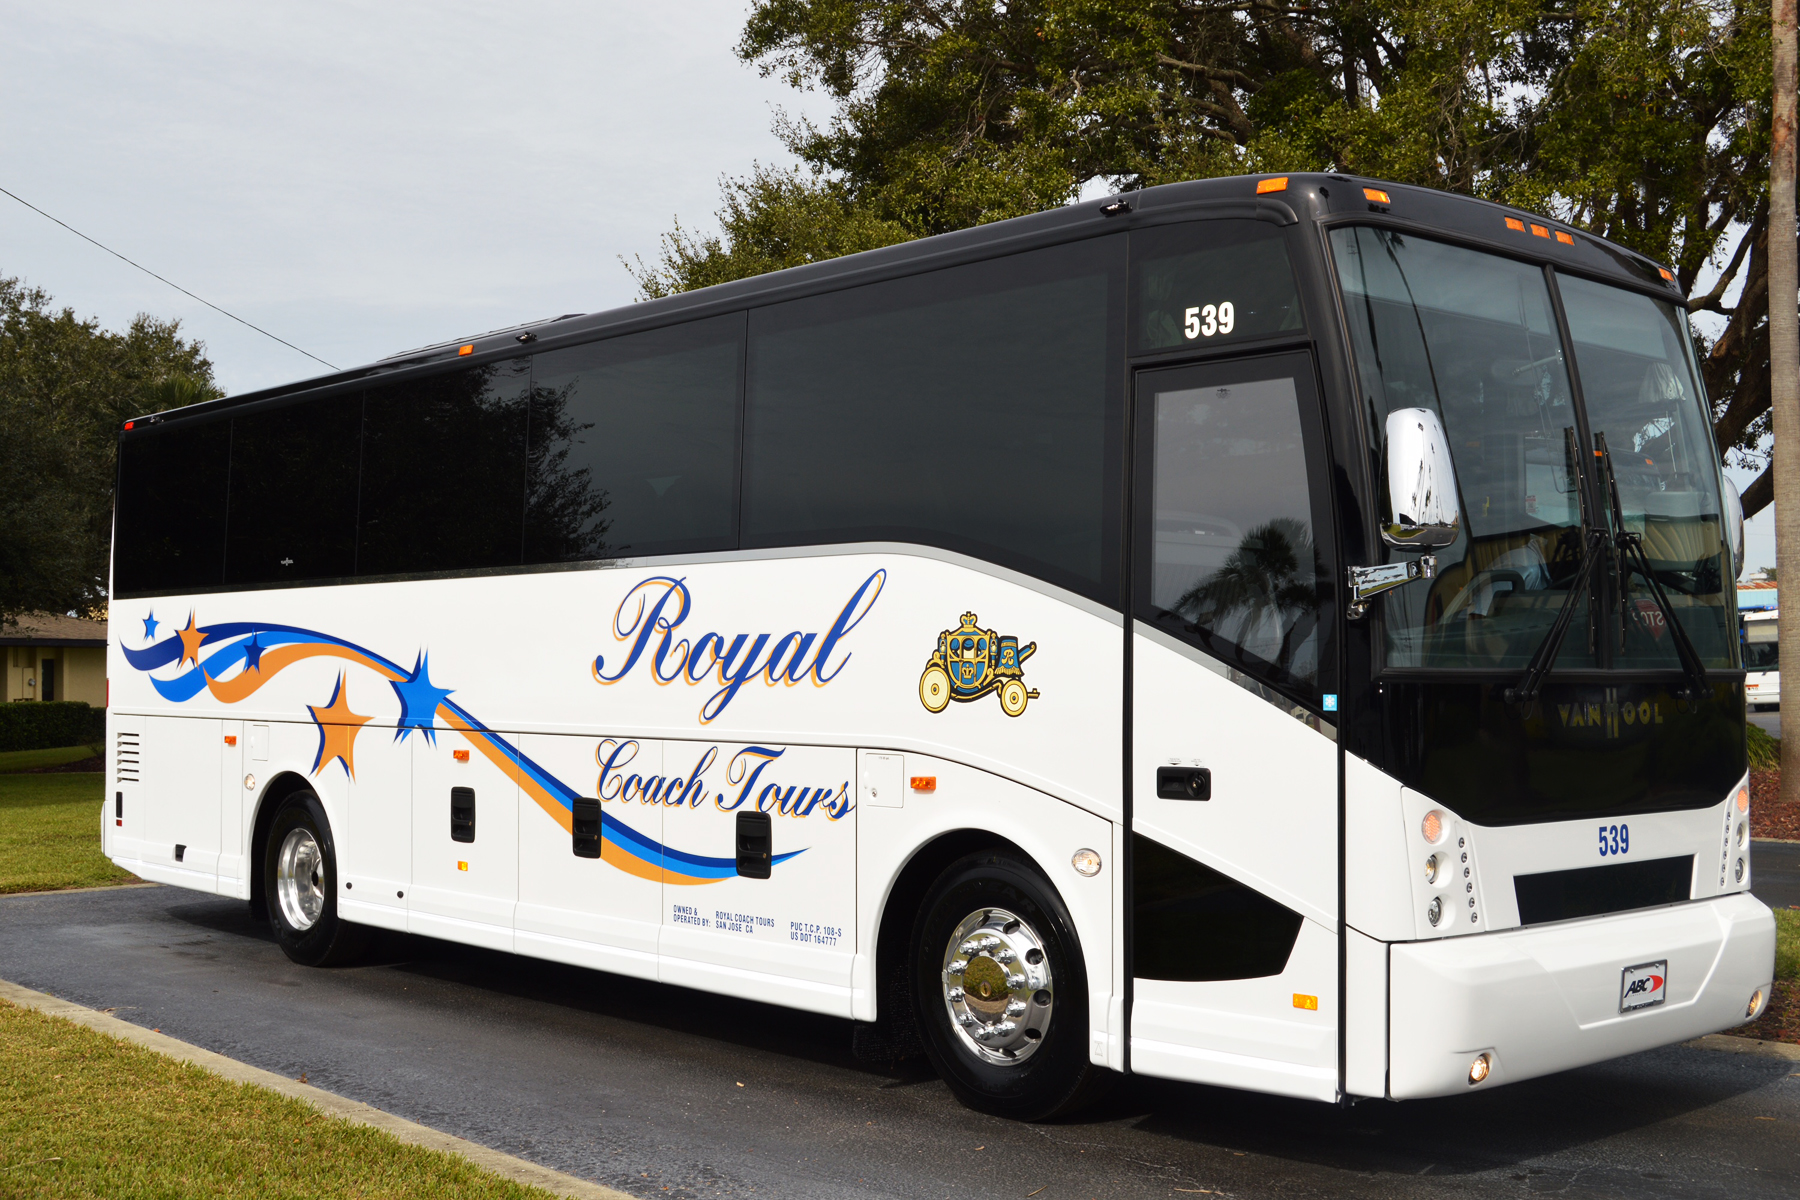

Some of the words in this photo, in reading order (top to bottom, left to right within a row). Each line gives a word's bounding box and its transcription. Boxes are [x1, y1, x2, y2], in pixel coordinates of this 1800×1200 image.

[1184, 301, 1235, 339] 539
[592, 568, 887, 725] Royal
[595, 738, 718, 808] Coach
[714, 745, 856, 821] Tours
[1598, 823, 1630, 857] 539
[673, 904, 692, 915] OWNED
[694, 907, 698, 916] &
[715, 910, 734, 922] ROYAL
[735, 913, 755, 925] COACH
[755, 916, 775, 928] TOURS
[673, 913, 701, 926] OPERATED
[702, 917, 711, 928] BY:
[715, 920, 727, 930] SAN
[728, 922, 742, 933] JOSE
[745, 924, 754, 934] CA
[790, 921, 803, 932] PUC
[823, 926, 842, 938] 108-S
[790, 931, 799, 941] US
[799, 932, 812, 943] DOT
[813, 934, 837, 947] 164777
[1624, 977, 1651, 998] ABC
